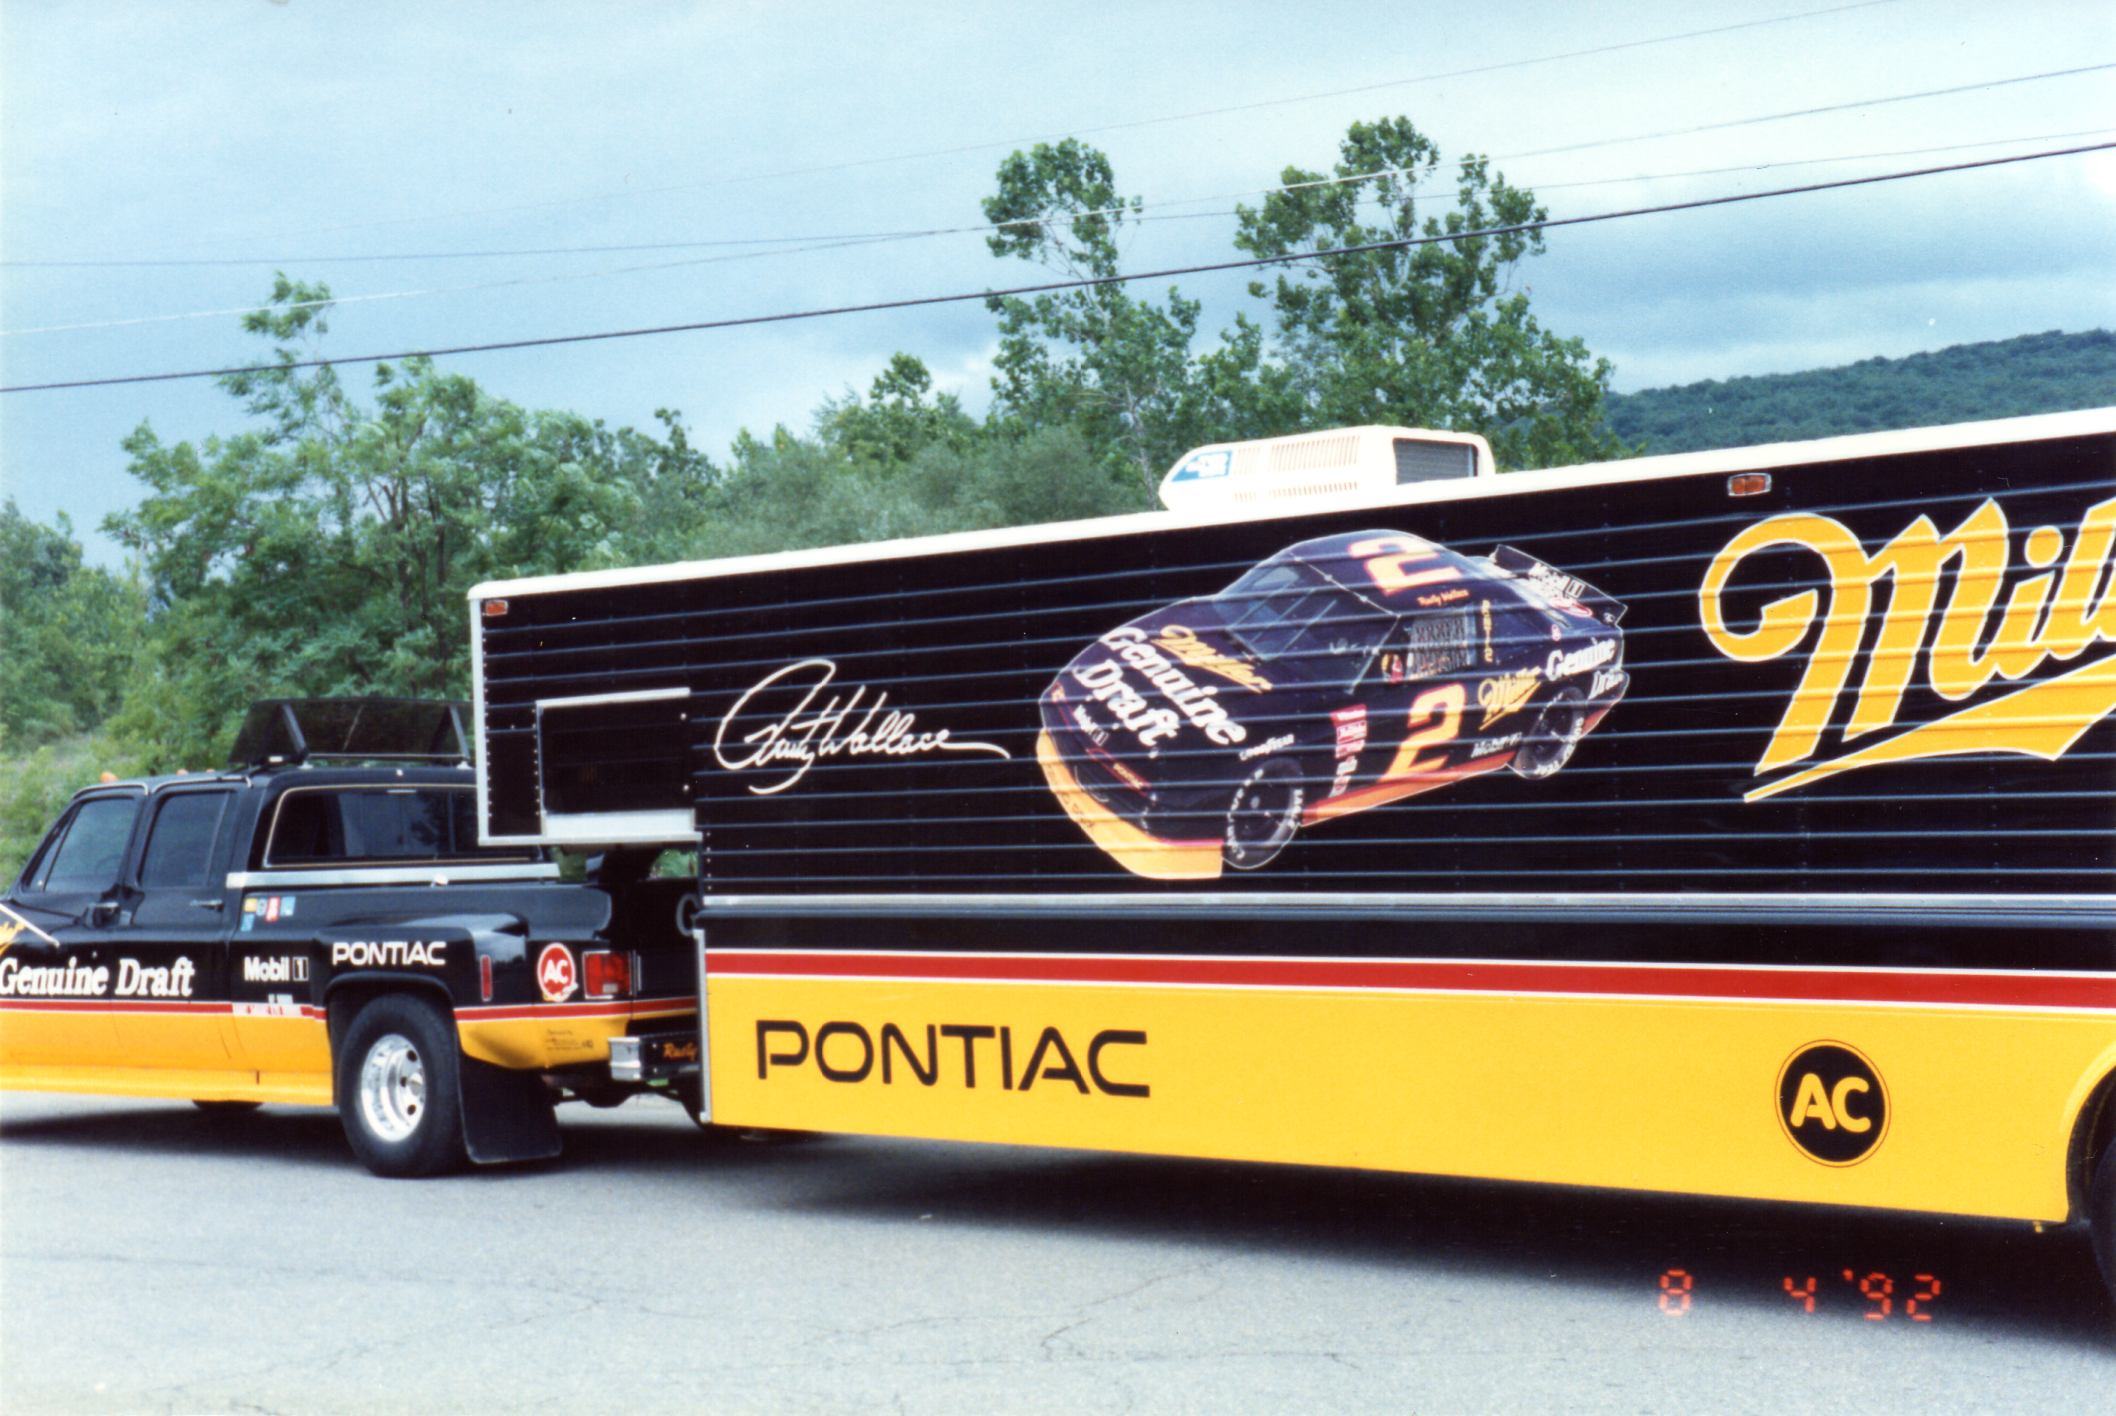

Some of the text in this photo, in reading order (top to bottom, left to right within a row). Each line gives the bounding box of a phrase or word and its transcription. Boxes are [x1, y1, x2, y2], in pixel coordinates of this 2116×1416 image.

[1347, 536, 1462, 597] 2
[1698, 497, 2116, 778] Mil
[1073, 658, 1181, 747] Draft
[1099, 627, 1247, 745] Genuine
[1378, 682, 1467, 763] 2
[0, 956, 195, 997] Genuine Draft
[244, 956, 290, 982] Mobil
[332, 941, 447, 967] PONTIAC
[543, 959, 569, 985] AC
[756, 1019, 1150, 1099] PONTIAC
[1790, 1073, 1871, 1133] AC
